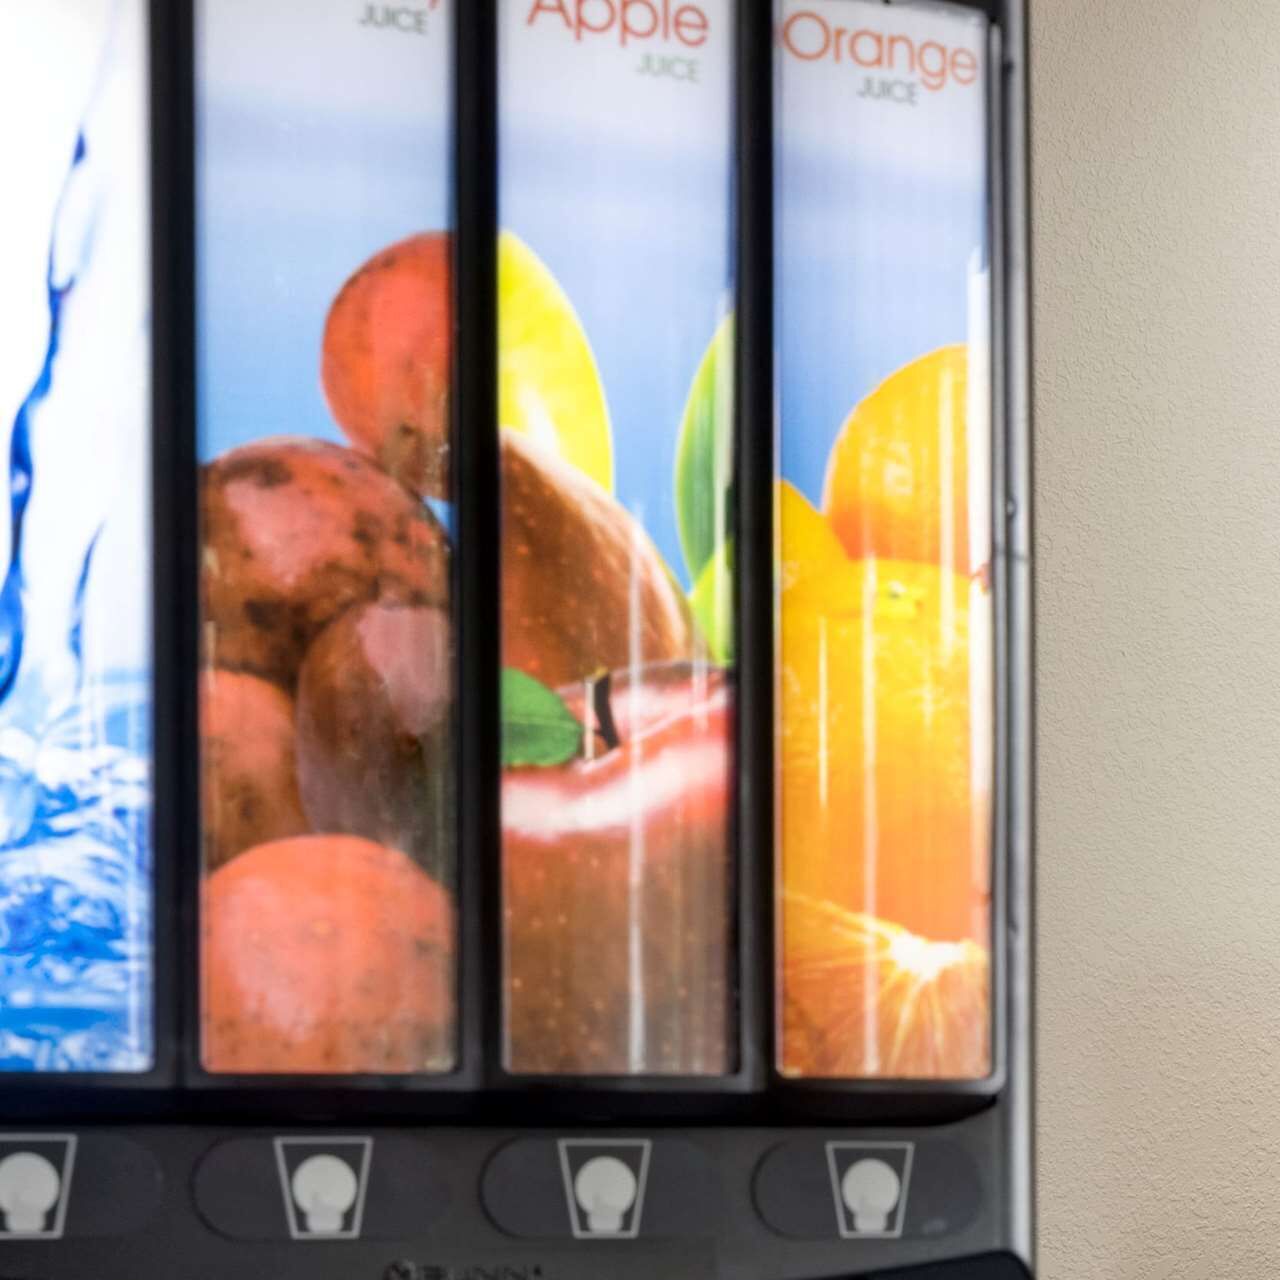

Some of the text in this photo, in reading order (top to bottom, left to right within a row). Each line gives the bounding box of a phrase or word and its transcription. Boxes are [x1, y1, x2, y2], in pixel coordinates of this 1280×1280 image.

[358, 4, 428, 35] JUICE
[783, 11, 977, 91] Orange
[636, 53, 700, 82] JUICE
[857, 76, 919, 106] JUICE
